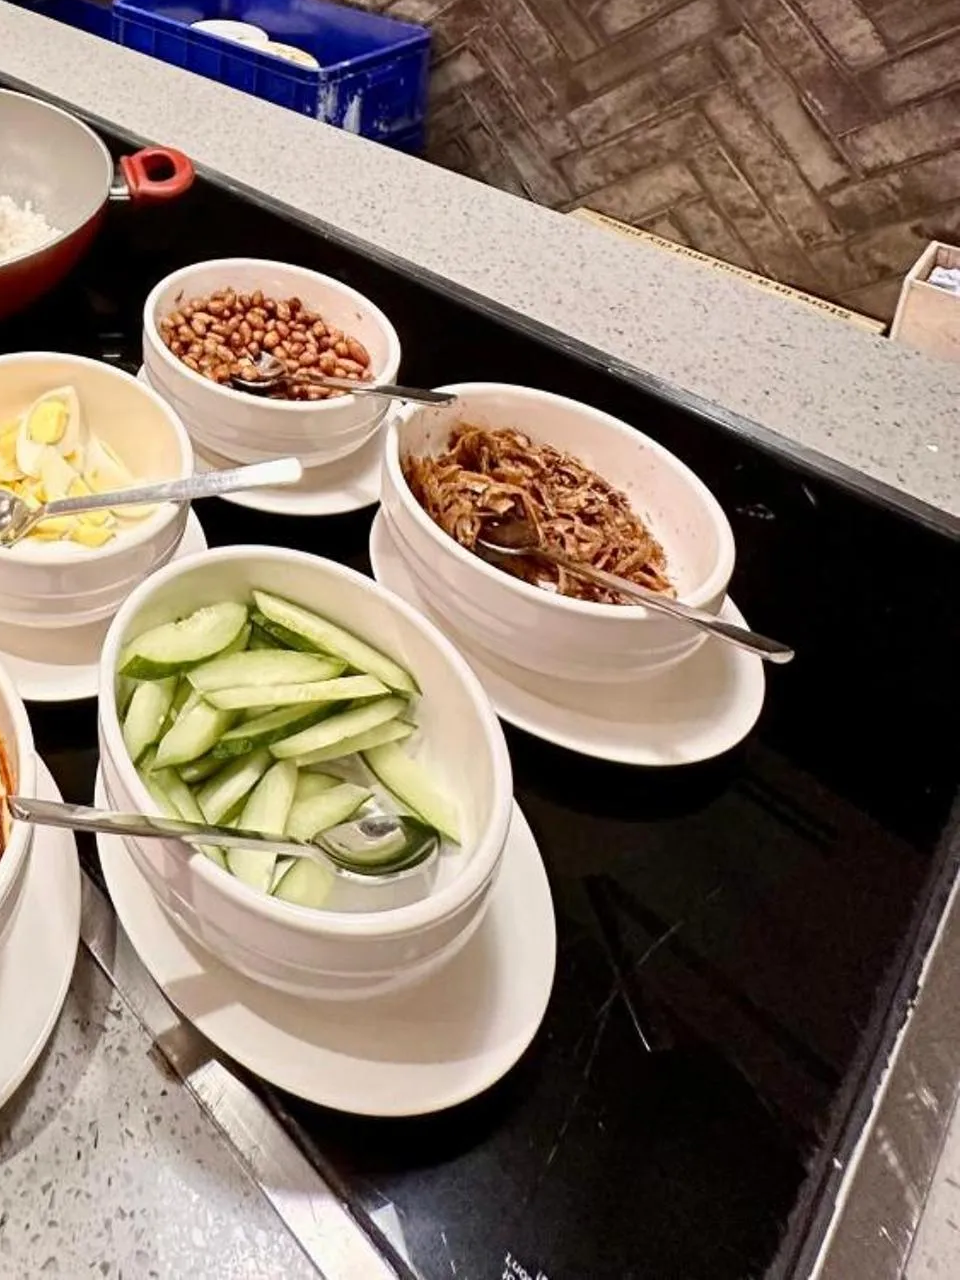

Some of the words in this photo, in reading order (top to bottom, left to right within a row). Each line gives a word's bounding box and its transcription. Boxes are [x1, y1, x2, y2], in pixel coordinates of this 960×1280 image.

[675, 247, 708, 261] and
[775, 286, 792, 295] in
[797, 295, 851, 318] Store
